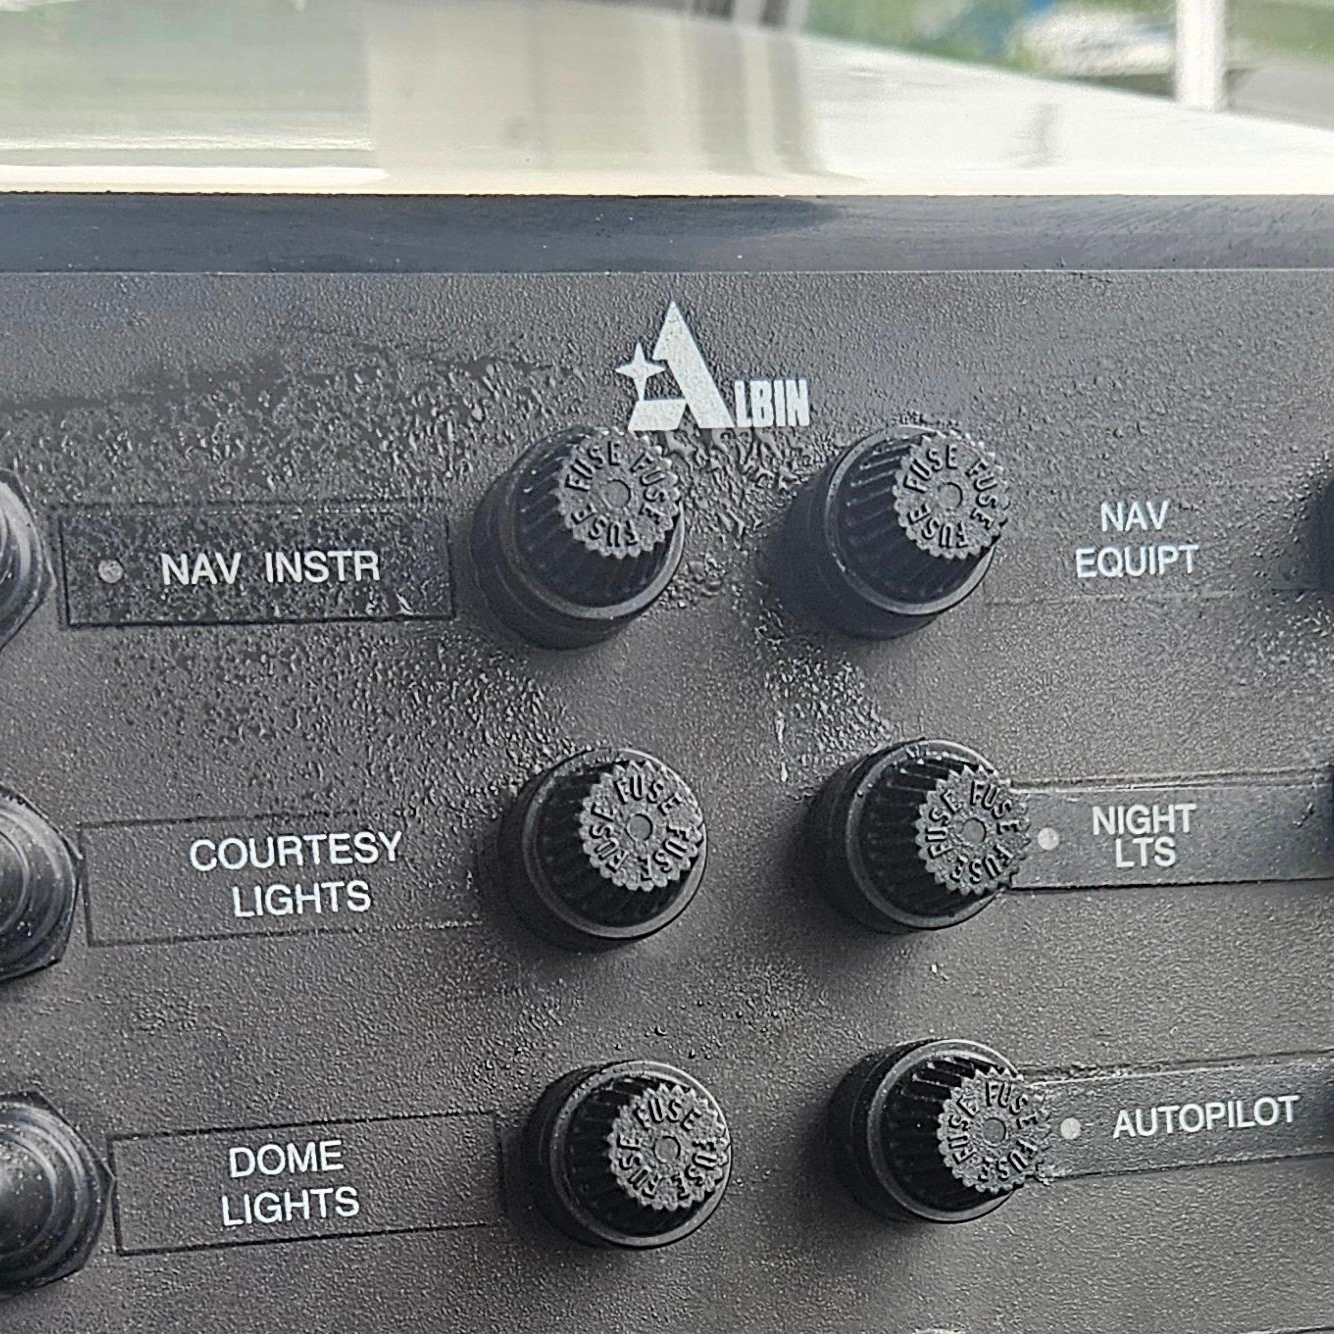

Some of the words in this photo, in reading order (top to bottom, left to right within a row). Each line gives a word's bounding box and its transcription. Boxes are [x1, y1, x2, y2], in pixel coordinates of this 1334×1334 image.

[615, 300, 811, 432] ALBIN
[564, 440, 621, 493] FUSE
[629, 451, 667, 527] FUSE
[903, 444, 959, 495] FUSE
[964, 457, 999, 531] FUSE
[1101, 501, 1169, 531] NAV
[570, 503, 639, 548] FUSE
[906, 502, 970, 549] FUSE
[162, 551, 241, 586] NAV
[265, 551, 380, 583] INSTR
[1076, 544, 1199, 580] EQUIPT
[612, 773, 682, 817] FUSE
[969, 780, 1021, 835] FUSE
[589, 802, 629, 874] FUSE
[924, 790, 963, 859] FUSE
[1092, 805, 1196, 835] NIGHT
[189, 833, 403, 872] COURTESY
[636, 825, 691, 882] FUSE
[950, 843, 1015, 885] FUSE
[1114, 837, 1176, 868] LTS
[233, 882, 372, 917] LIGHTS
[632, 1097, 702, 1132] FUSE
[985, 1081, 1040, 1130] FUSE
[1113, 1095, 1300, 1140] AUTOPILOT
[946, 1094, 980, 1165] FUSE
[229, 1141, 344, 1178] DOME
[615, 1134, 663, 1199] FUSE
[670, 1140, 718, 1201] FUSE
[977, 1138, 1039, 1182] FUSE
[222, 1187, 360, 1227] LIGHTS
